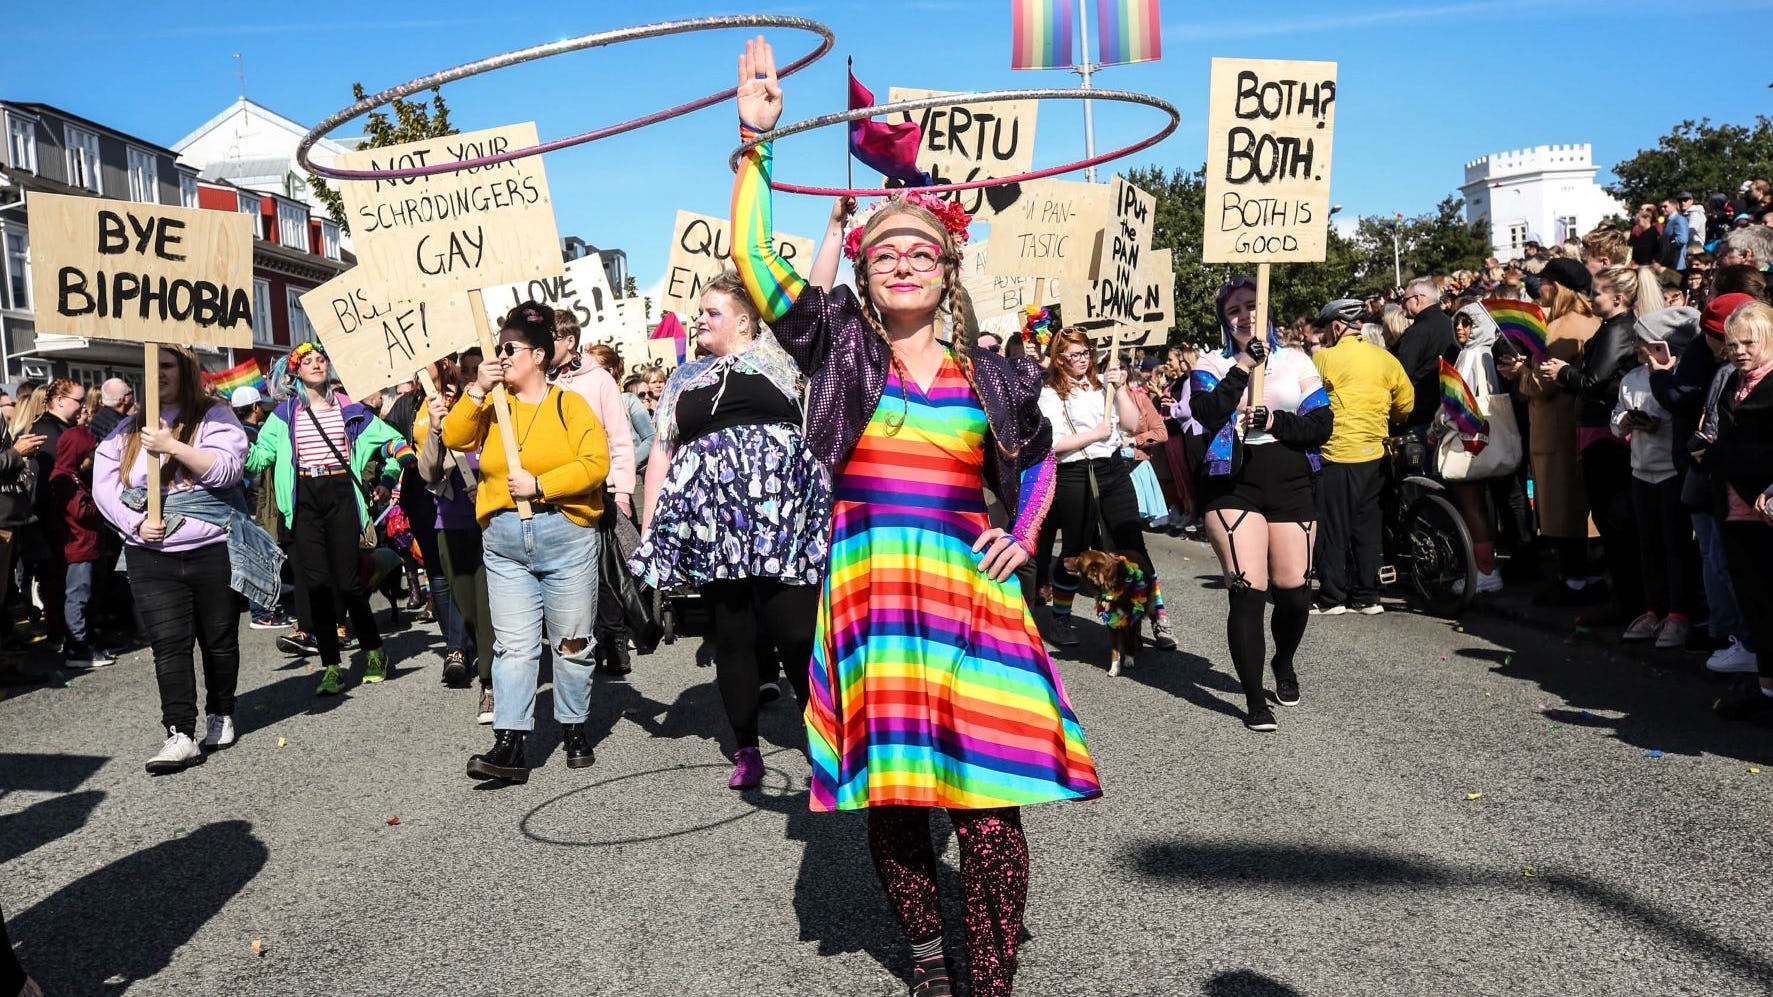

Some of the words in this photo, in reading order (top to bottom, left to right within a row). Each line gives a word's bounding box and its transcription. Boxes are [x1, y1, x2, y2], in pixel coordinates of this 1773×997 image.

[1235, 70, 1336, 130] BOTH?
[902, 99, 1019, 161] VERTU
[1225, 126, 1322, 184] BOTH.
[371, 149, 431, 193] NOT
[446, 136, 515, 177] YOUR
[1117, 180, 1123, 217] I
[1221, 192, 1287, 231] BOTH
[1294, 200, 1312, 226] IS
[97, 210, 187, 262] BYE
[416, 225, 484, 275] GAY
[1017, 233, 1070, 259] TASTIC
[1112, 236, 1140, 270] PAN
[57, 265, 253, 330] BIPHOBIA
[1100, 278, 1143, 322] PANIC
[1116, 263, 1130, 289] IN
[382, 301, 431, 370] AF!
